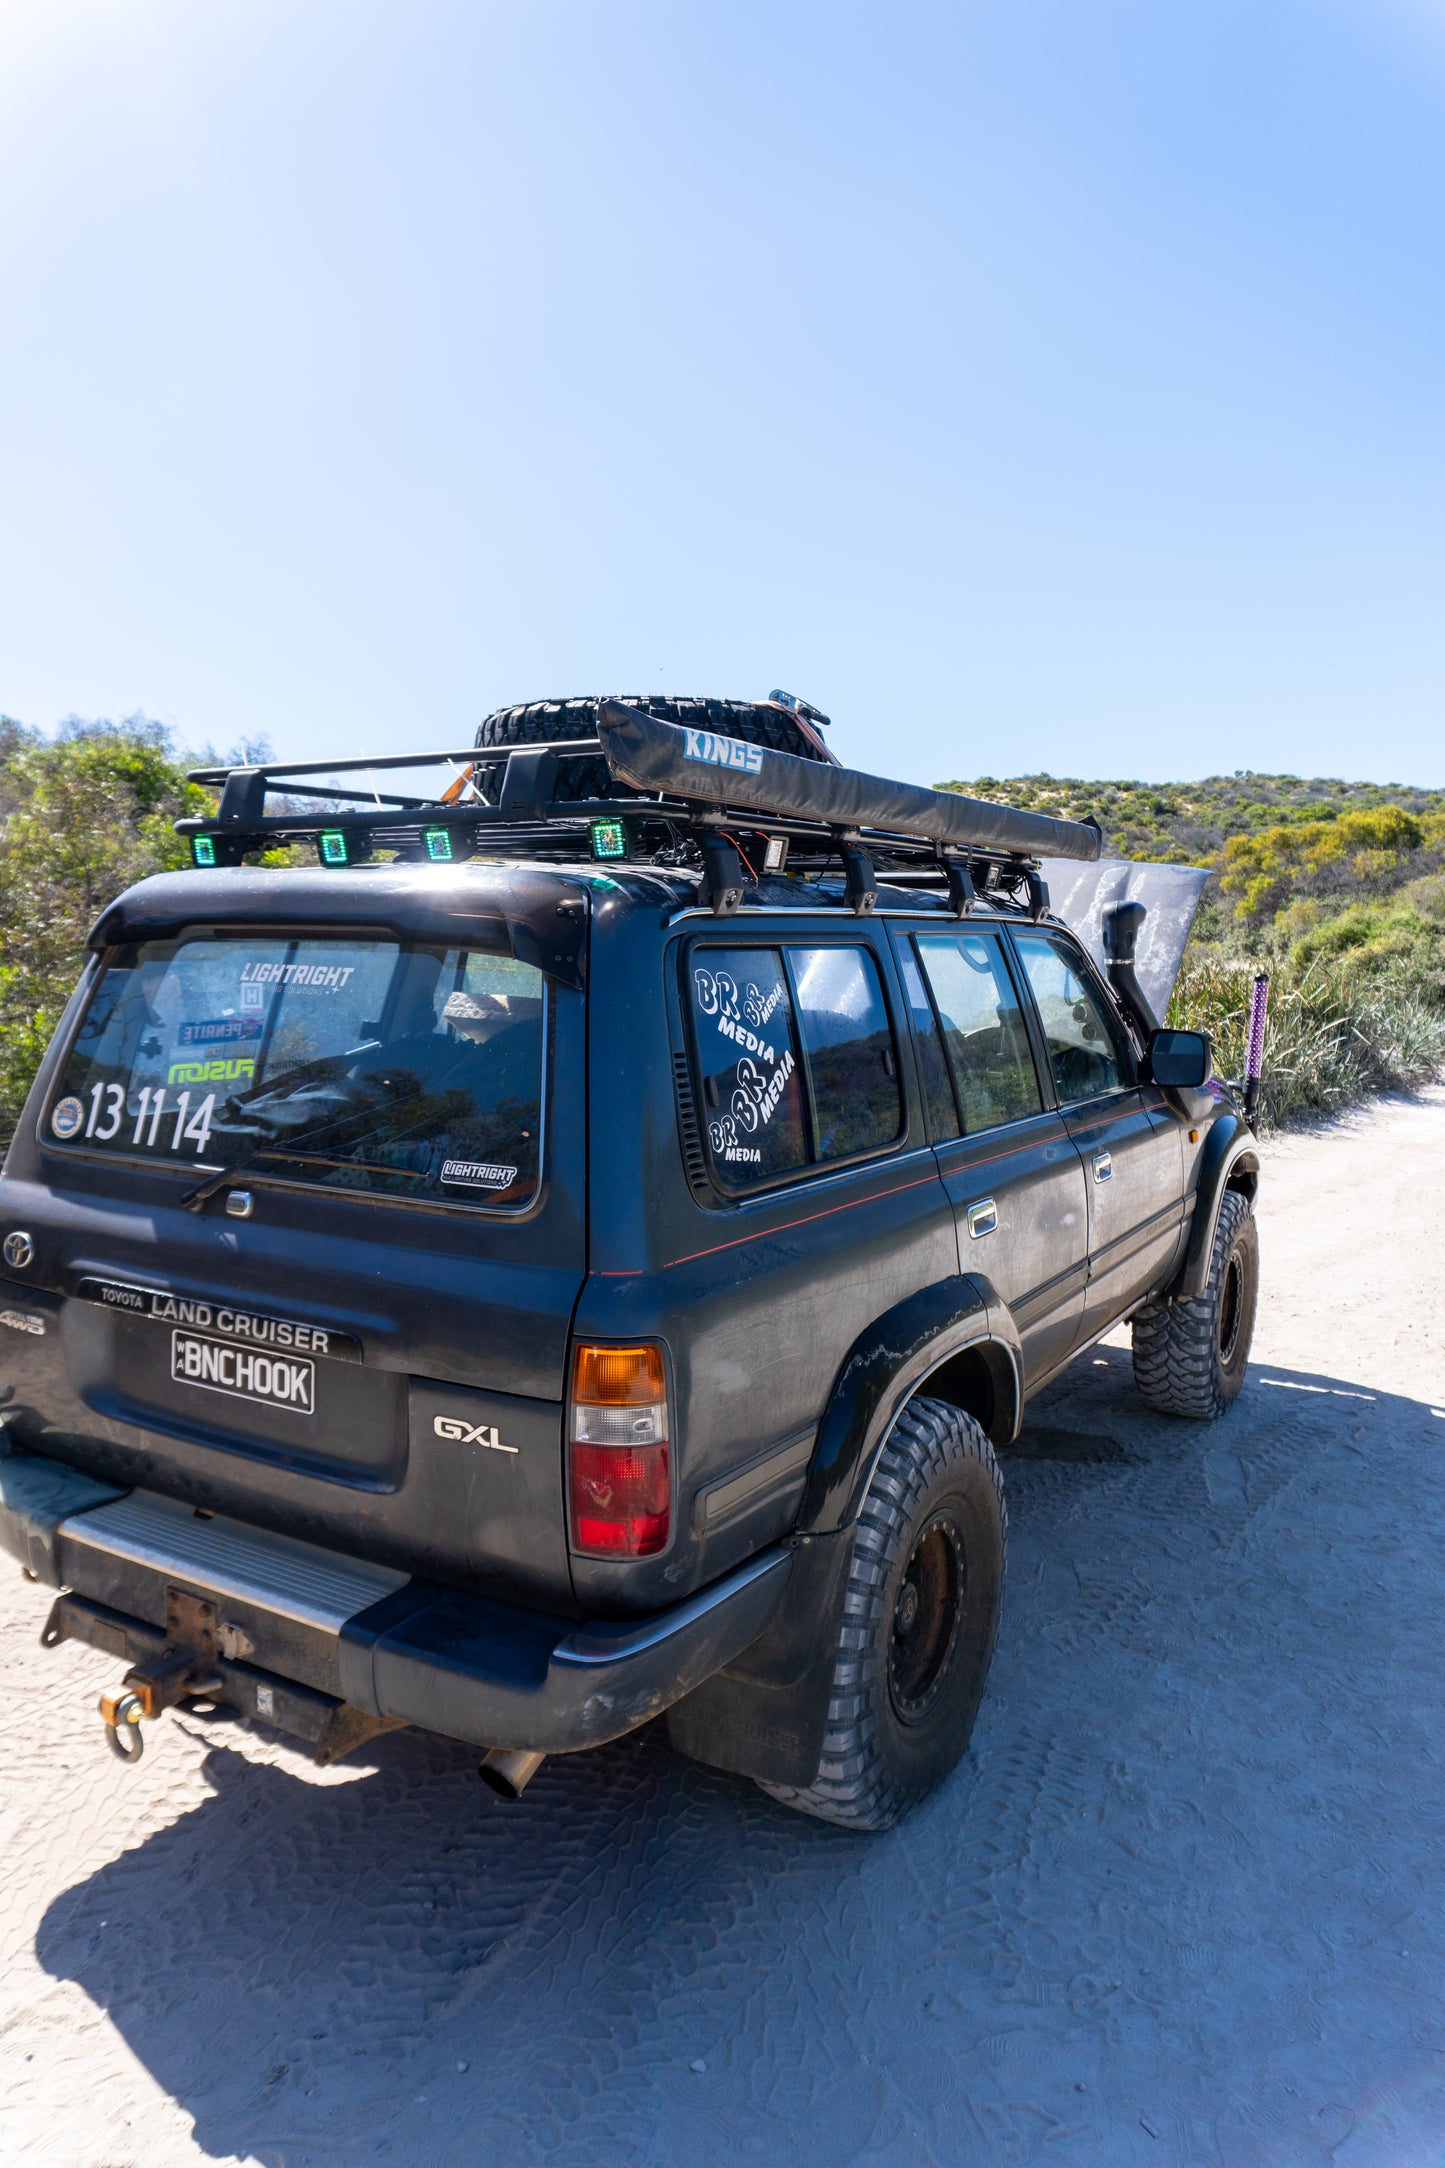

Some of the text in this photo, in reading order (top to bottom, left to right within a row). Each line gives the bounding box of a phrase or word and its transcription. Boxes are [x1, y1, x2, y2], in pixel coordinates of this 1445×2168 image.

[686, 729, 763, 771] KINGS
[240, 962, 355, 987] LIGHTRIGHT
[694, 968, 741, 1021] BR
[743, 983, 765, 1027] BR
[761, 983, 784, 1025] MEDIA
[717, 1015, 775, 1065] MEDIA
[731, 1057, 767, 1133] BR
[760, 1050, 795, 1125] MEDIA
[85, 1082, 216, 1154] 13 11 14
[708, 1114, 739, 1153] BR
[444, 1163, 515, 1181] LIGHTRIGHT
[725, 1147, 761, 1163] MEDIA
[101, 1287, 329, 1354] TOYOTA LAND CRUISER
[184, 1340, 310, 1405] BNCHOOK
[433, 1415, 519, 1454] GXL
